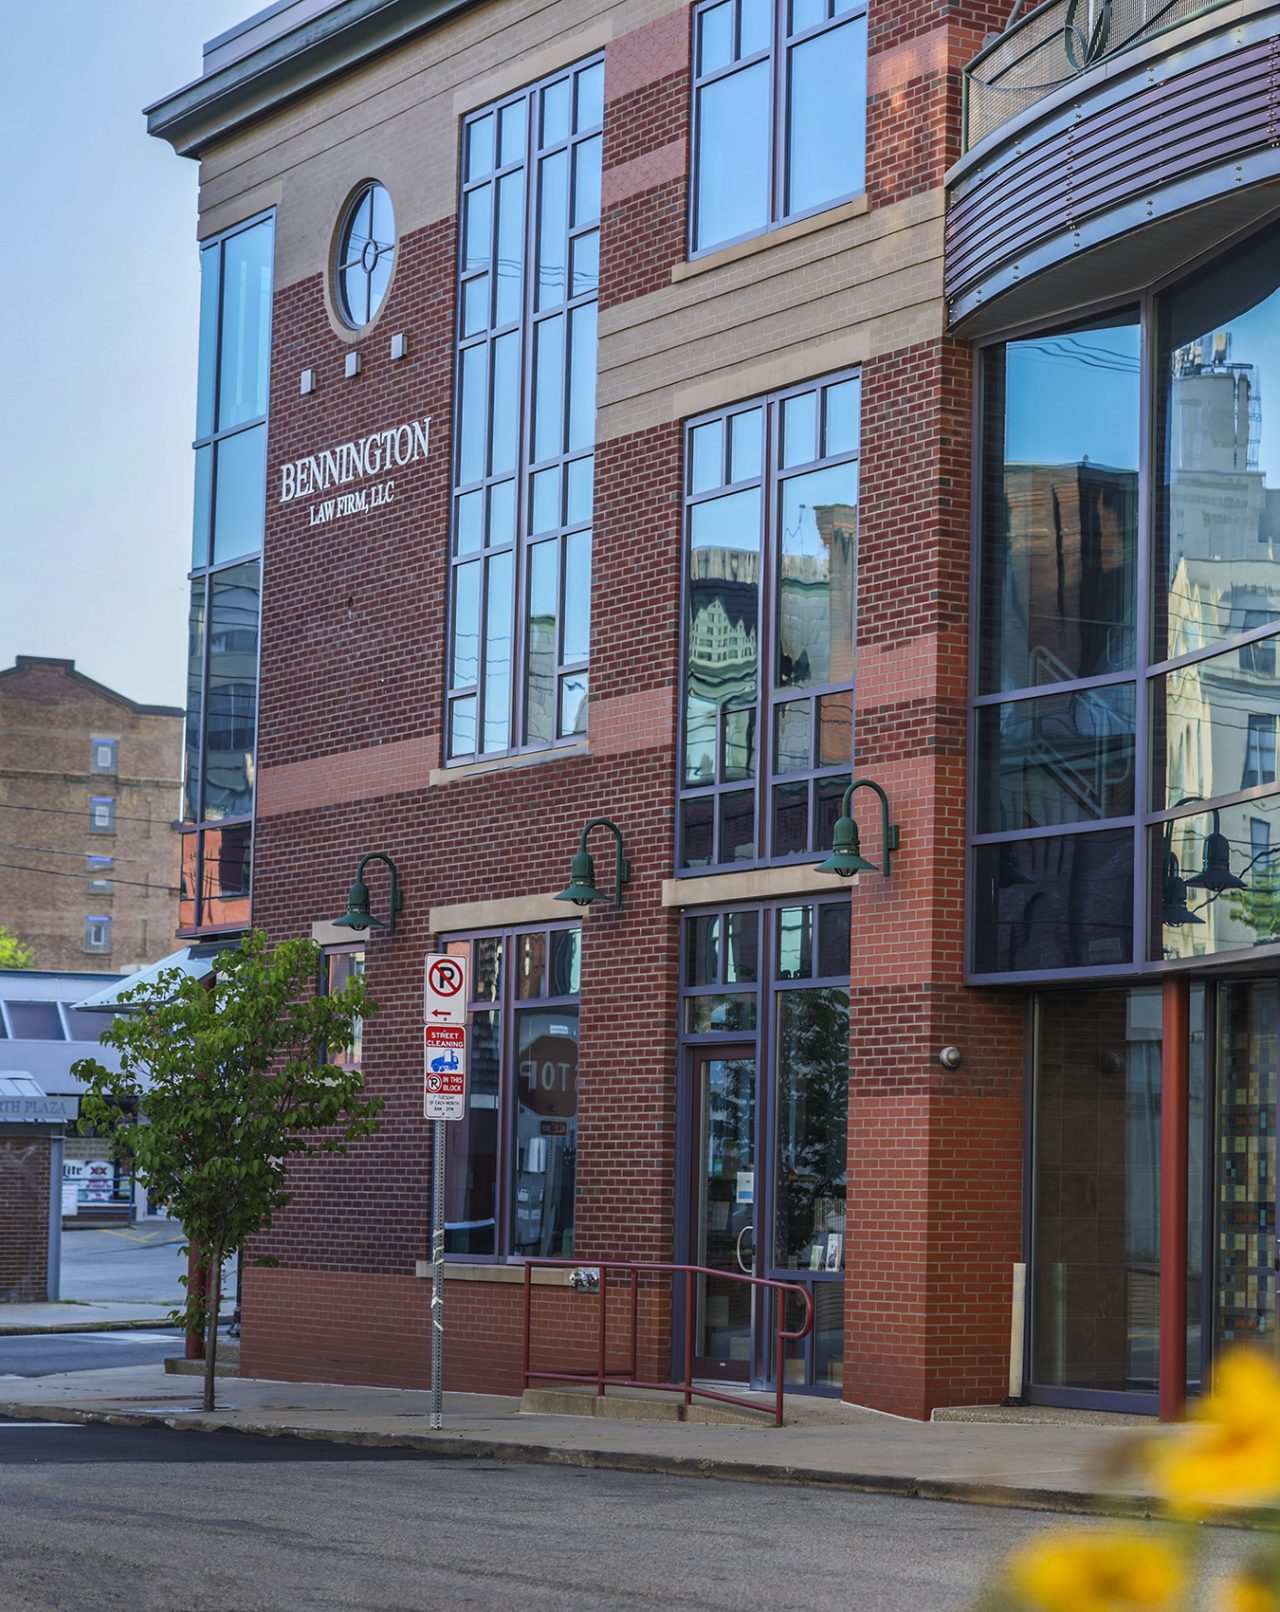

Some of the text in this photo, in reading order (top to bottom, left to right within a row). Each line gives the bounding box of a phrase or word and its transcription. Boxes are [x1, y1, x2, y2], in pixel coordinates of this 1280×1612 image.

[280, 416, 432, 503] BENNINGTON
[309, 481, 395, 527] LAW FIRM, LLC
[426, 1040, 464, 1048] CLEANING
[450, 1076, 463, 1084] THIS
[442, 1084, 462, 1092] BLOCK
[25, 1101, 66, 1114] PLAZA
